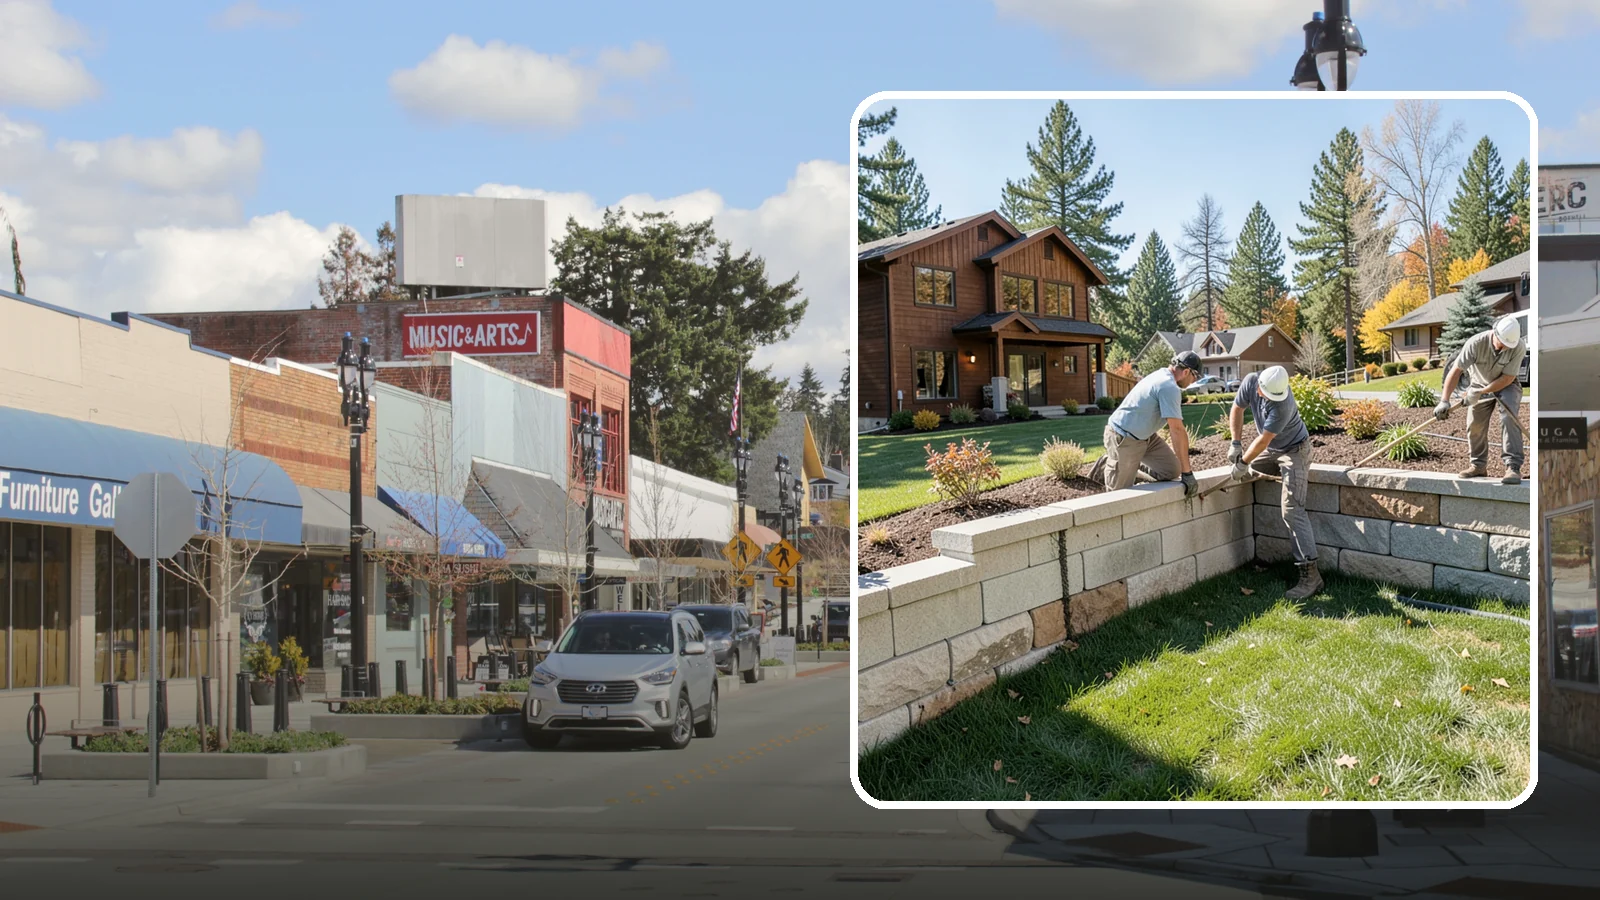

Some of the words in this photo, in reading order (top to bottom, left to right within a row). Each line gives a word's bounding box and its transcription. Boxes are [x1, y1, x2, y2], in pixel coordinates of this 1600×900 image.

[409, 323, 519, 349] MUSIC&ARTS
[1540, 427, 1577, 437] UGA
[1552, 436, 1579, 445] Framing
[0, 471, 79, 515] Furniture
[90, 482, 121, 519] Gal
[453, 563, 479, 574] SUSHI
